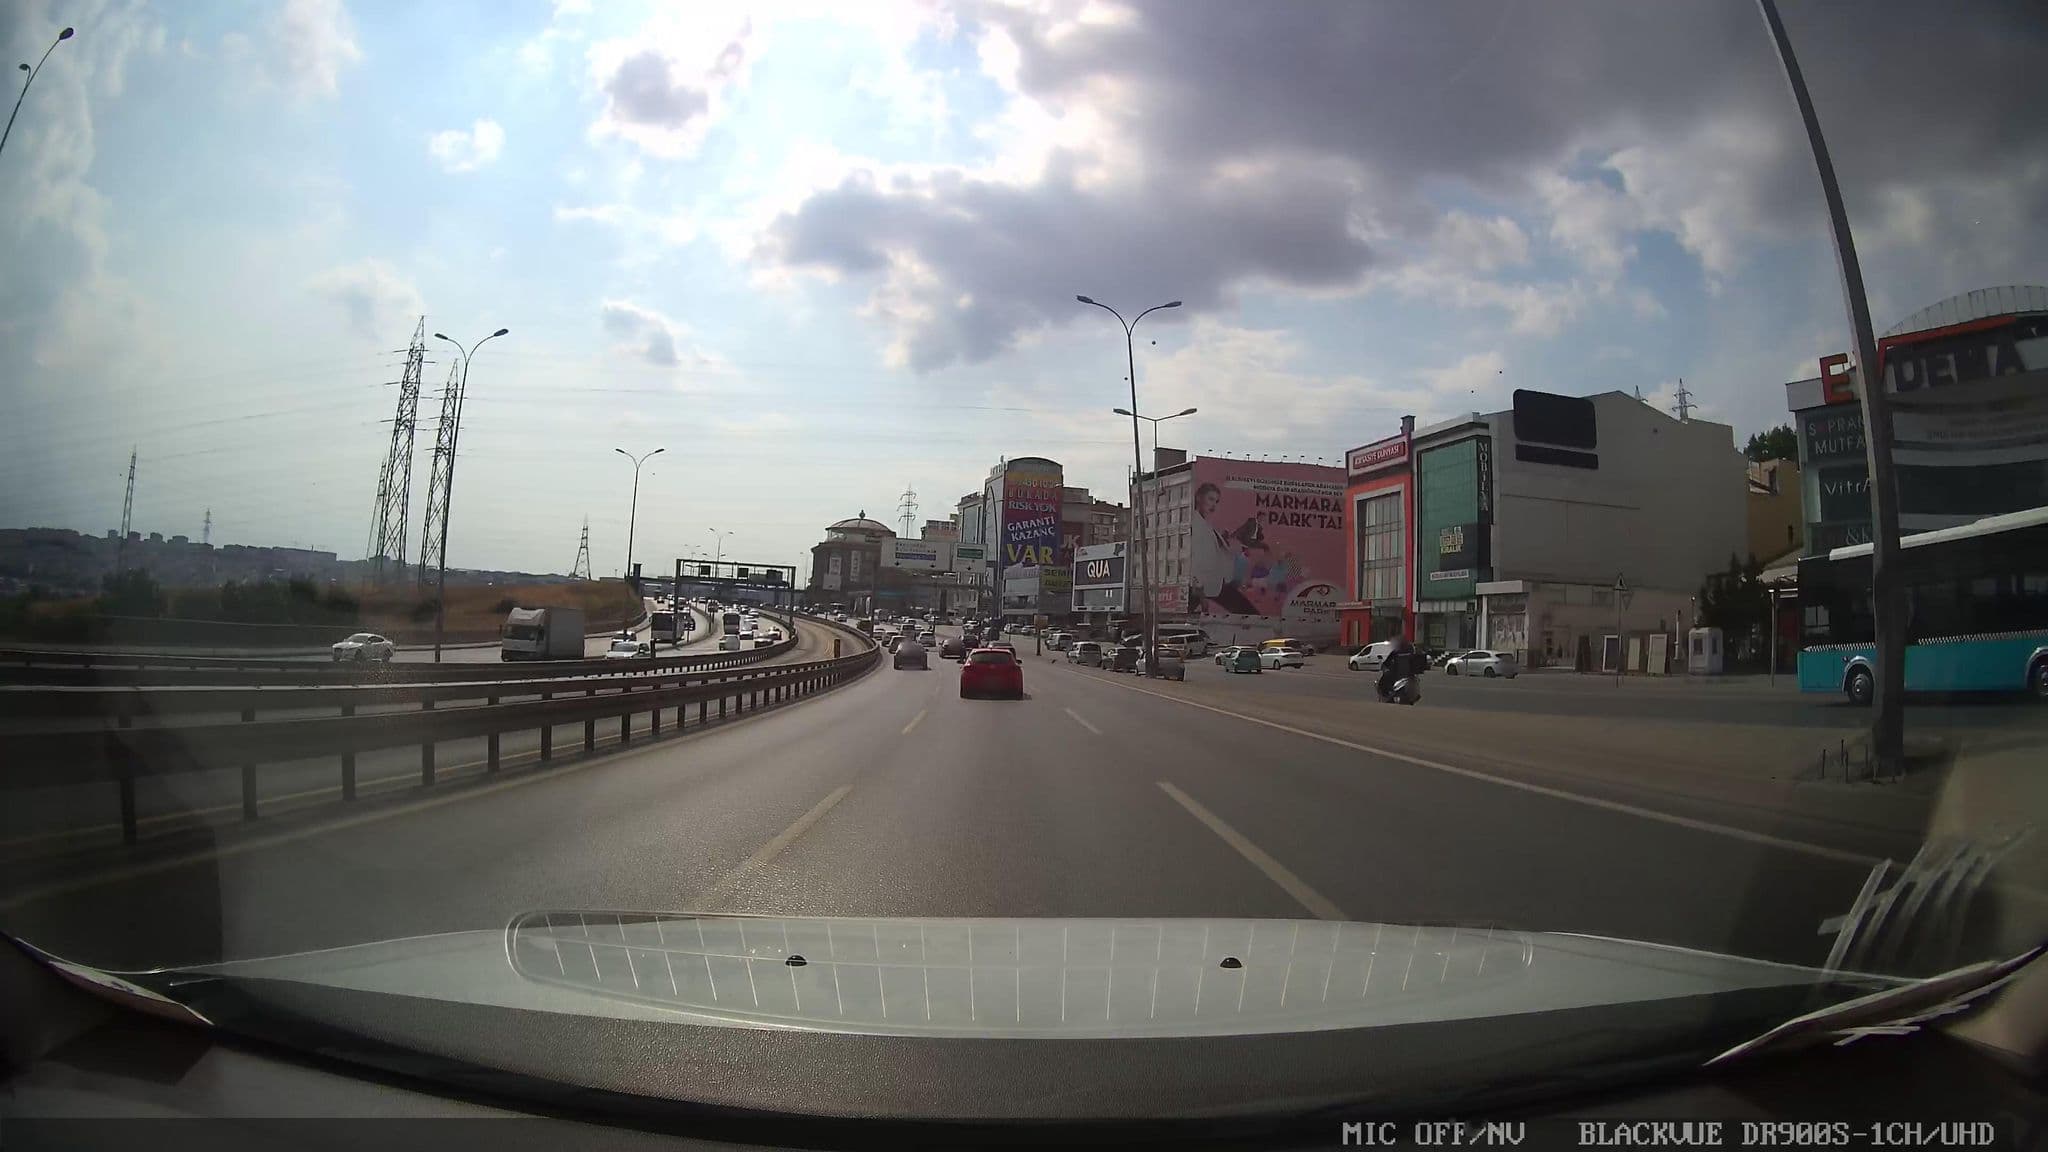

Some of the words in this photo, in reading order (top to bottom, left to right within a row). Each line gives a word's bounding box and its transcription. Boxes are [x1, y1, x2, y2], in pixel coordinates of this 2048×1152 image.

[1815, 435, 1865, 454] MUTFA
[1256, 493, 1342, 512] MARMARA
[1268, 511, 1342, 529] PARK'TA!
[1011, 526, 1056, 541] KAZANÇ
[1007, 543, 1054, 564] VAR
[1087, 560, 1111, 578] QUA
[1289, 600, 1337, 608] MARMAR
